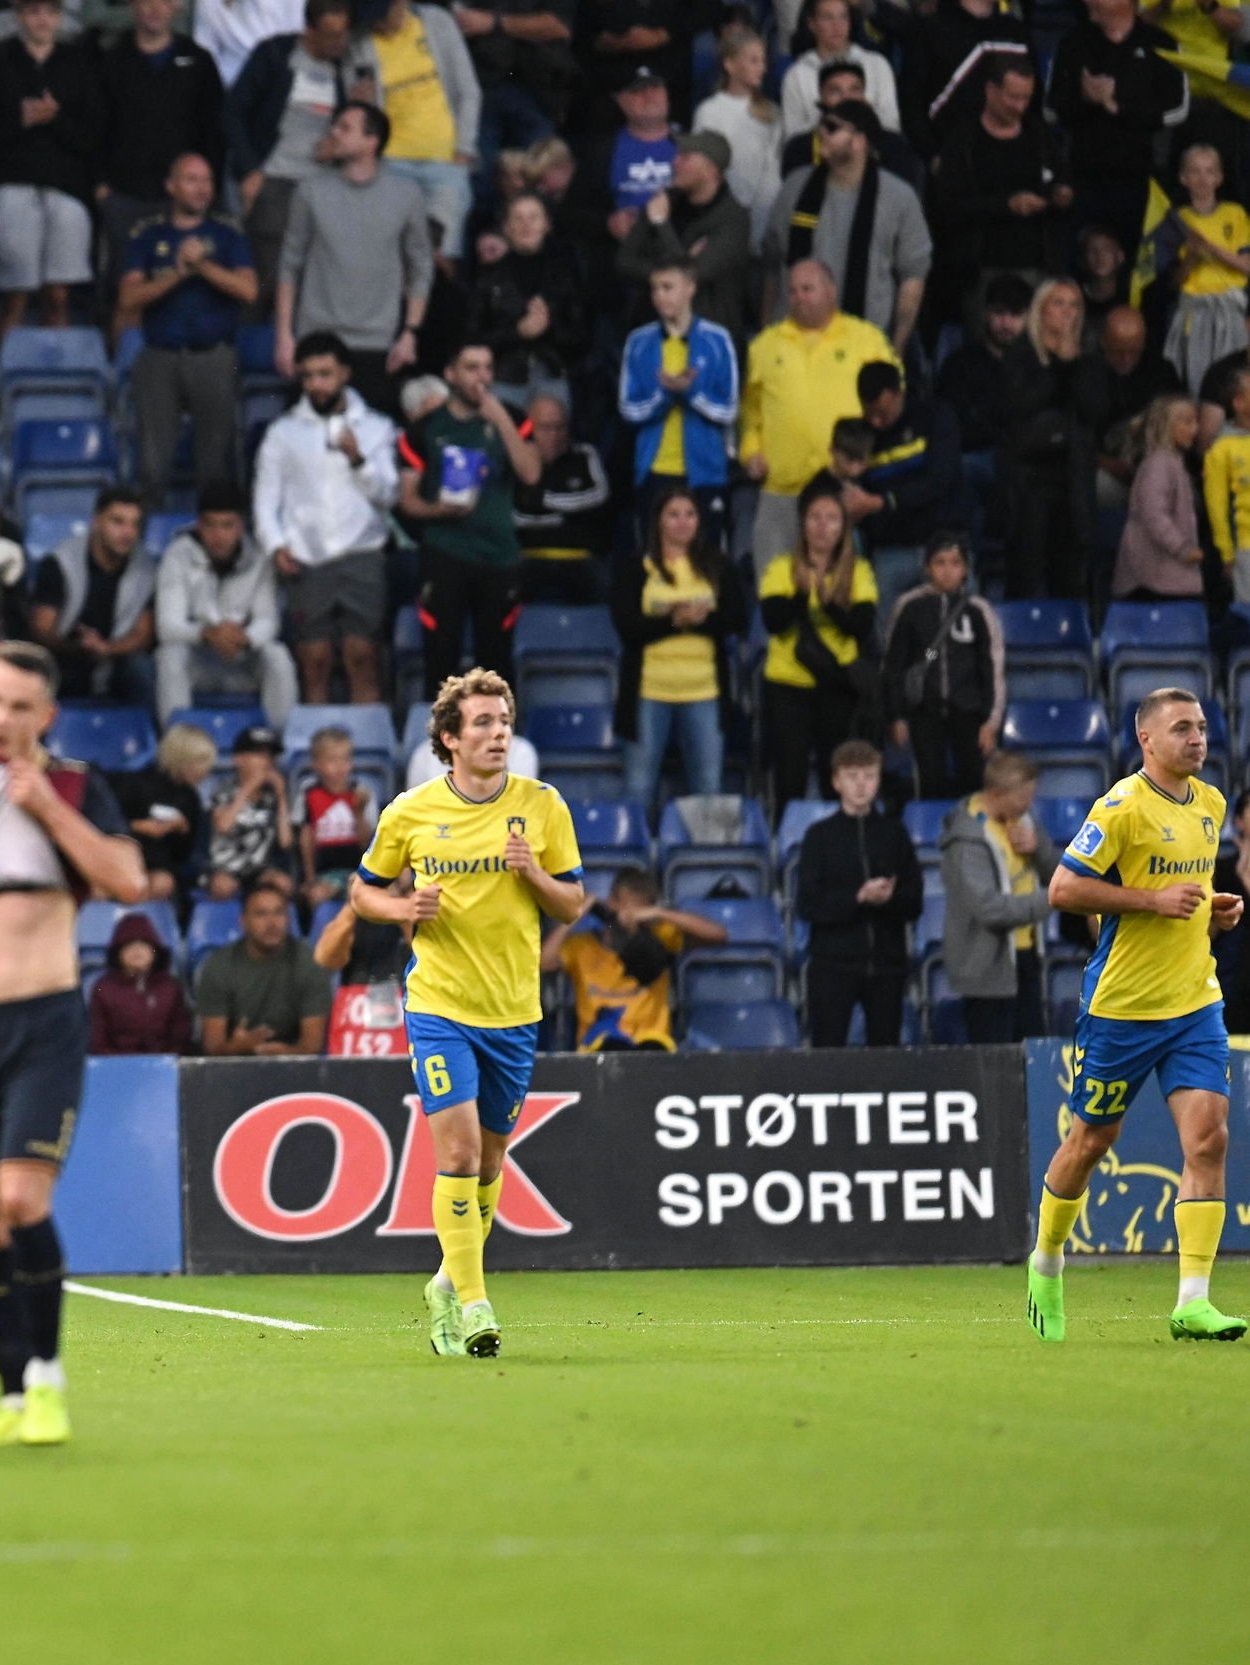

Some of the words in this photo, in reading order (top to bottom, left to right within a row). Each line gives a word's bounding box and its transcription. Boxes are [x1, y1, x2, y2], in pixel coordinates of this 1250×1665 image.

[425, 1054, 452, 1097] 6
[1084, 1078, 1129, 1115] 22
[654, 1090, 980, 1150] STØTTER
[213, 1092, 581, 1241] OK
[657, 1167, 996, 1227] SPORTEN
